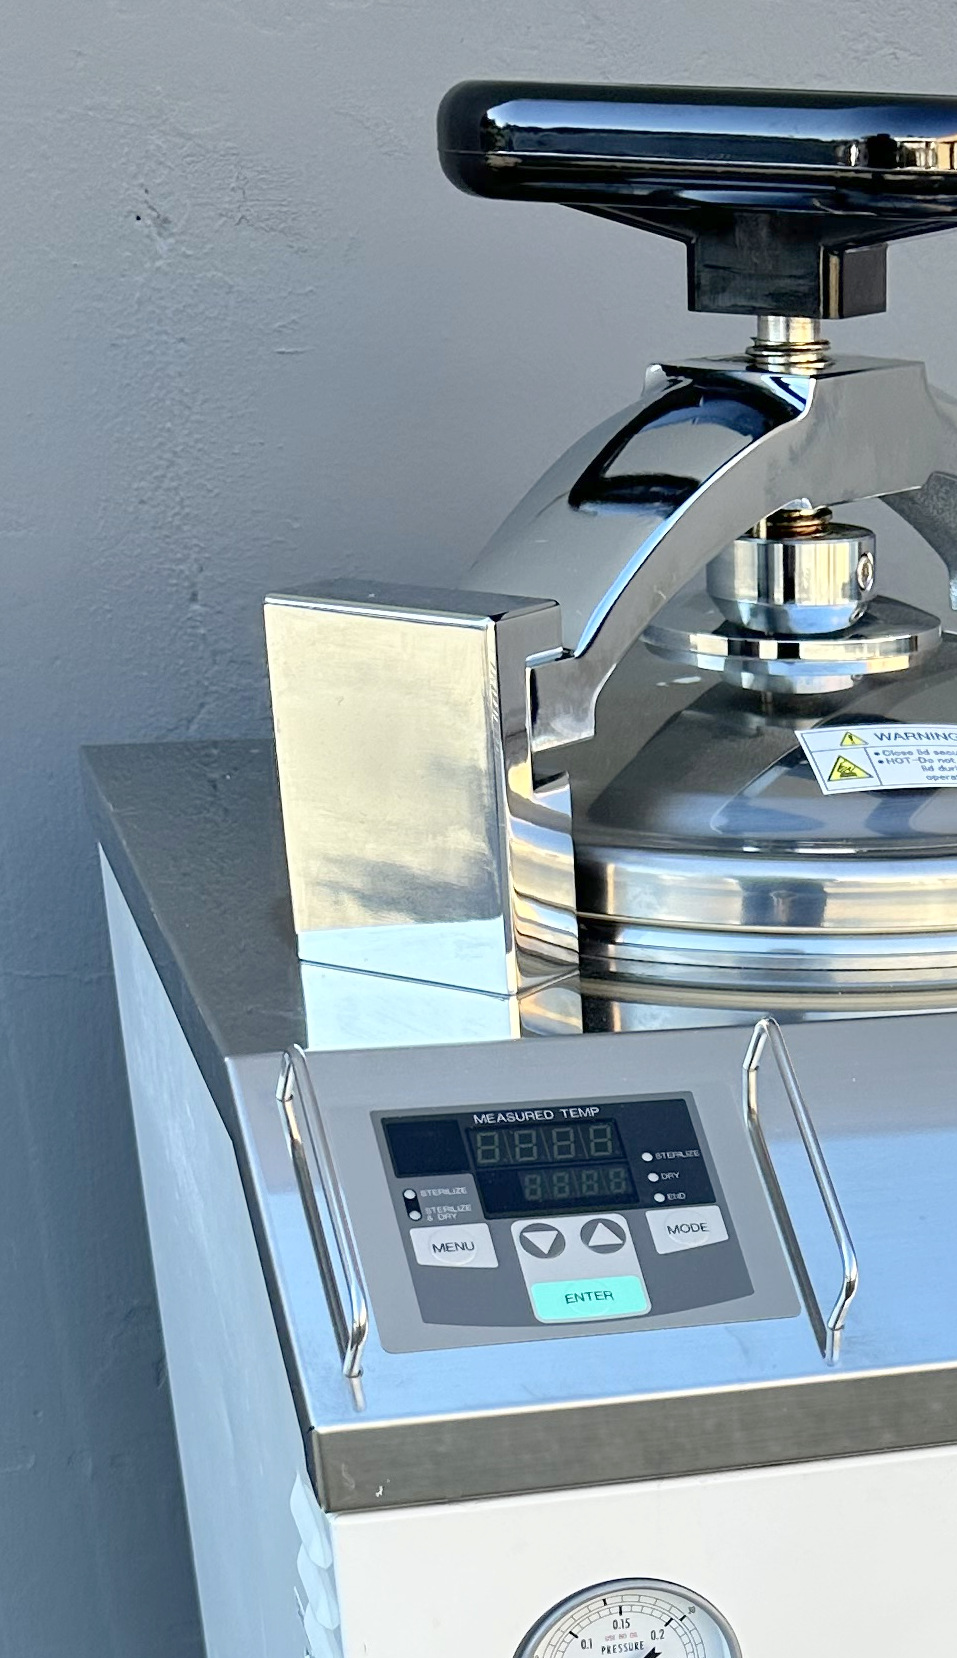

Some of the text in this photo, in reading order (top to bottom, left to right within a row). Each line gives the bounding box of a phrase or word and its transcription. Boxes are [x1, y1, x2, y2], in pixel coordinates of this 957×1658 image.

[473, 1107, 600, 1125] MEASURED TEMP
[661, 1172, 679, 1180] DRY
[420, 1187, 468, 1197] STERILIZE
[425, 1204, 472, 1215] STERILIZE
[437, 1213, 458, 1221] DRY
[666, 1221, 709, 1235] MODE
[432, 1240, 476, 1254] MENU
[565, 1289, 615, 1305] ENTER
[612, 1618, 631, 1630] 0.15
[650, 1629, 665, 1640] 0.2
[580, 1638, 593, 1650] 0.1
[601, 1641, 644, 1655] PRESSURE
